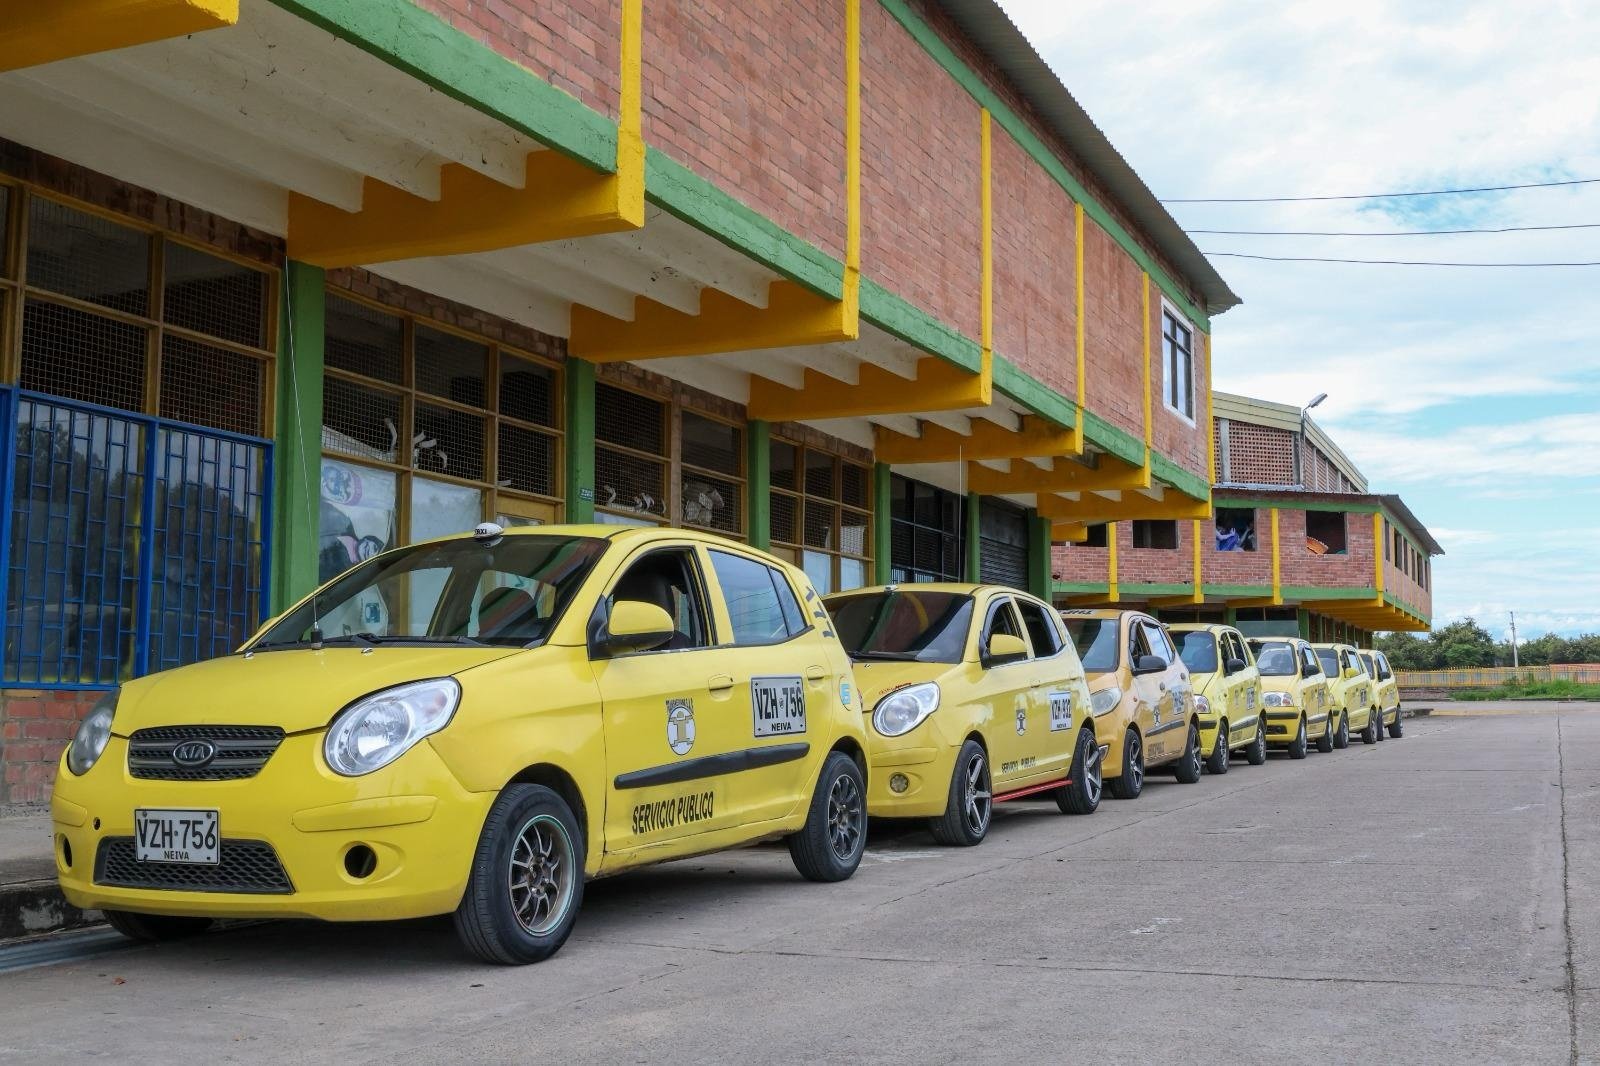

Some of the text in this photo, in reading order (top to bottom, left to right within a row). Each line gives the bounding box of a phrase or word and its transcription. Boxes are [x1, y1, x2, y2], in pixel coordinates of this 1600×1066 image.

[755, 686, 804, 720] VZH 756
[771, 721, 792, 732] NEIVA
[179, 745, 205, 759] KIA
[631, 791, 714, 835] SERVICIO PUBLICO
[137, 818, 217, 850] VZH 756
[163, 850, 190, 860] NEIVA
